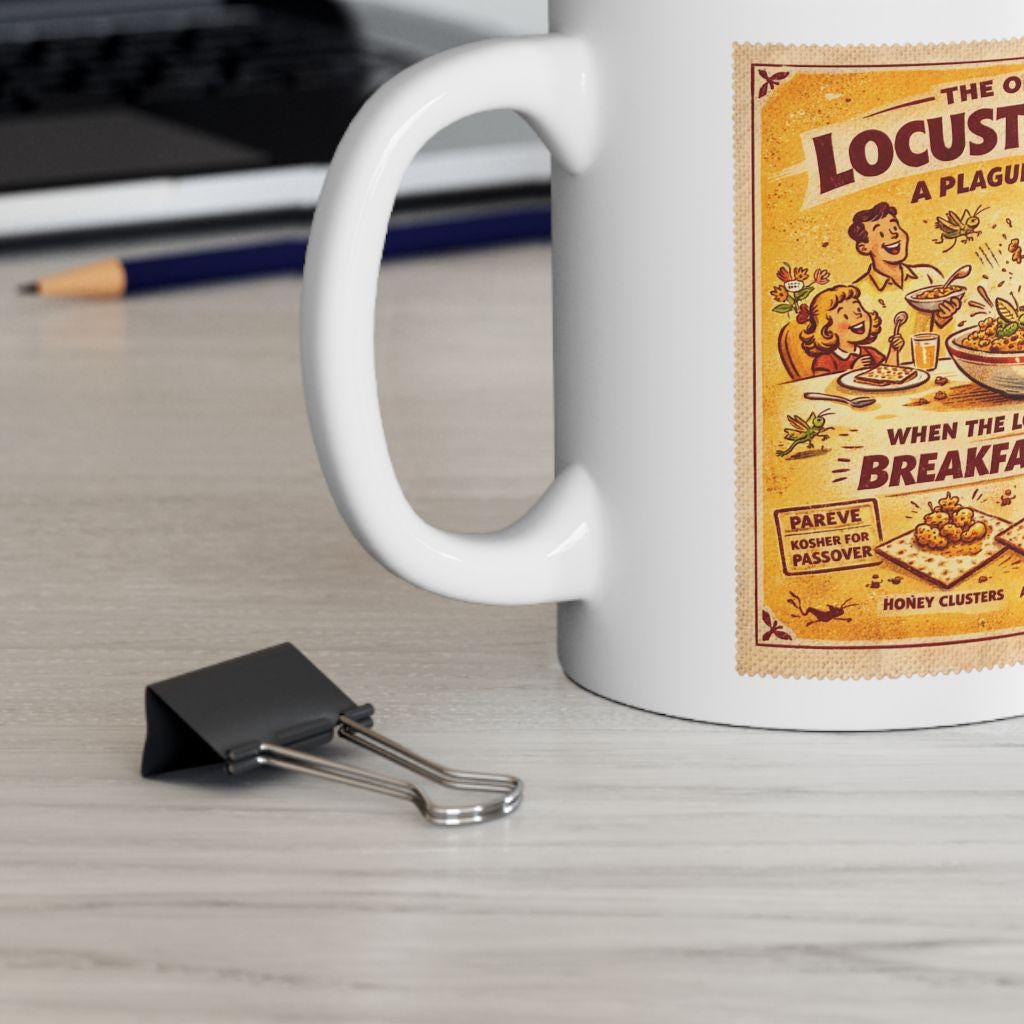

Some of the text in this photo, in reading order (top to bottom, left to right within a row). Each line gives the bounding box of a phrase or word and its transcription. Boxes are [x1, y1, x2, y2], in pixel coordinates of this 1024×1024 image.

[940, 80, 994, 105] THE
[910, 180, 932, 204] A
[887, 425, 958, 446] WHEN
[965, 417, 1005, 439] THE
[789, 509, 862, 530] PAREVE
[790, 531, 870, 551] KOSHER FOR
[792, 546, 872, 566] PASSOVER
[883, 590, 1005, 611] HONEY CLUSTERS
